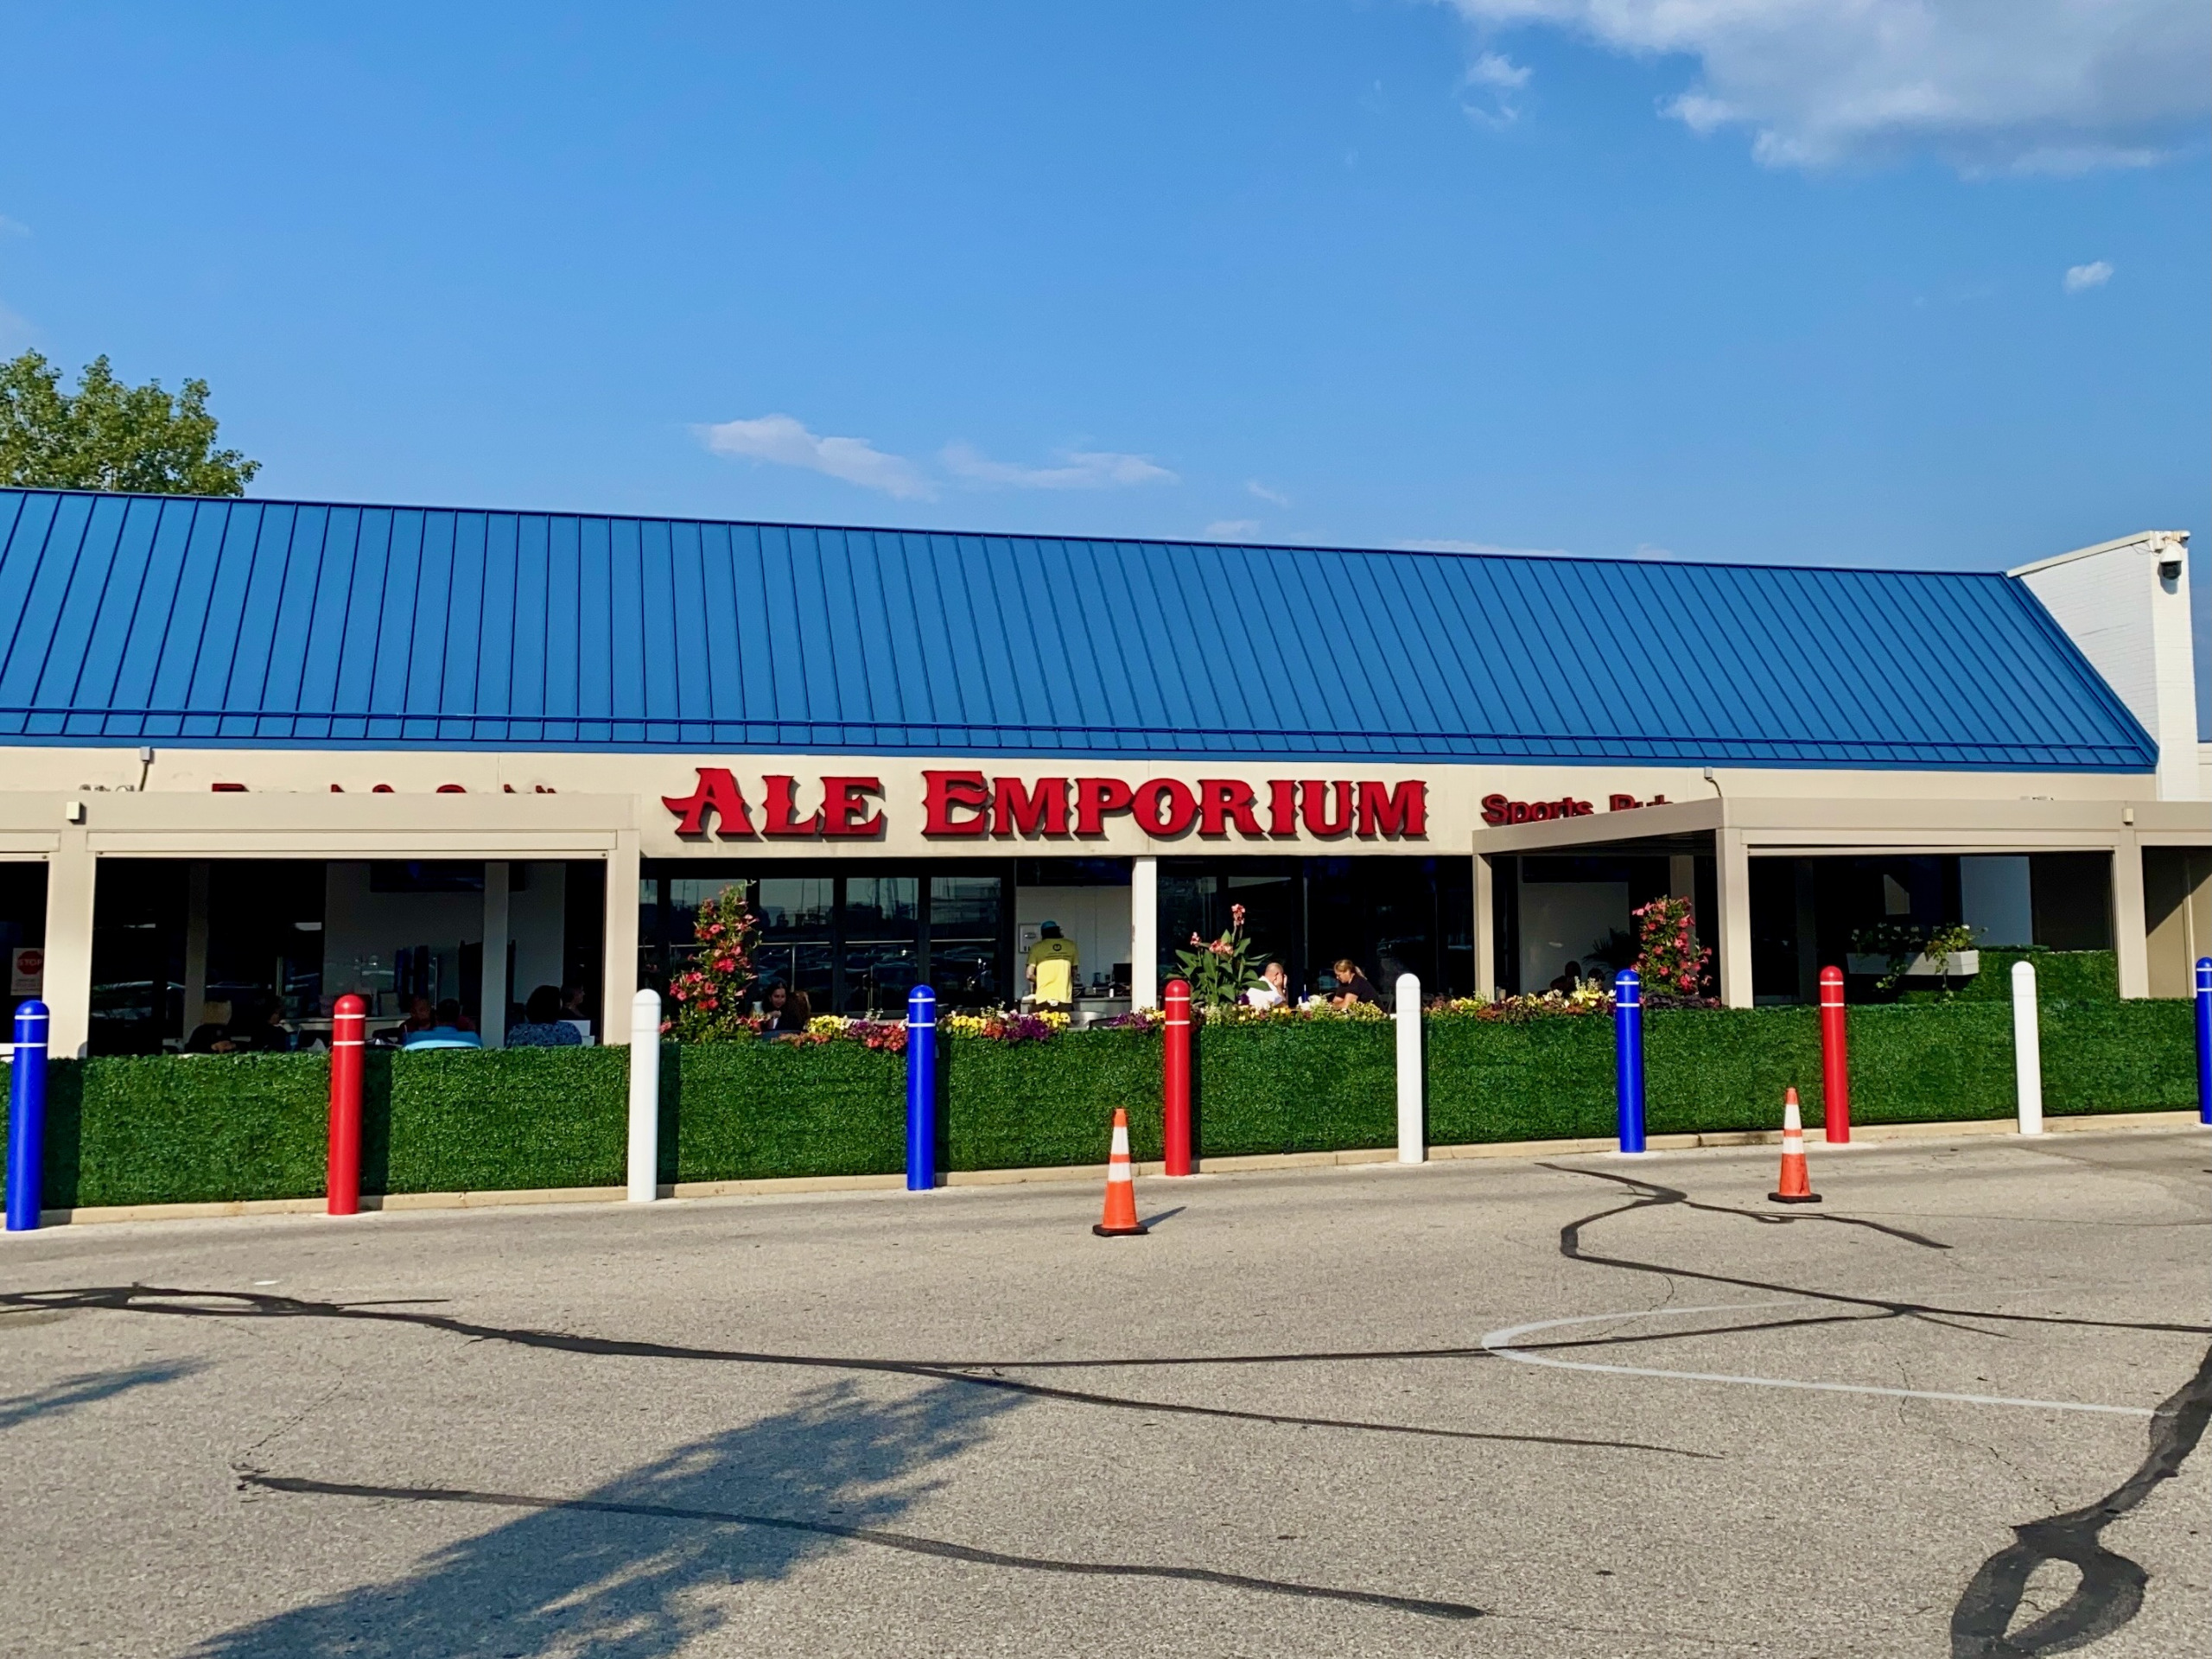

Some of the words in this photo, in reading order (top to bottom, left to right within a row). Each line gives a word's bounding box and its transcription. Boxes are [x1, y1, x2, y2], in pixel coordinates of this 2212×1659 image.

[661, 767, 882, 836] ALE
[921, 770, 1427, 836] EMPORIUM
[1481, 794, 1594, 825] Sports
[18, 957, 42, 967] STOP
